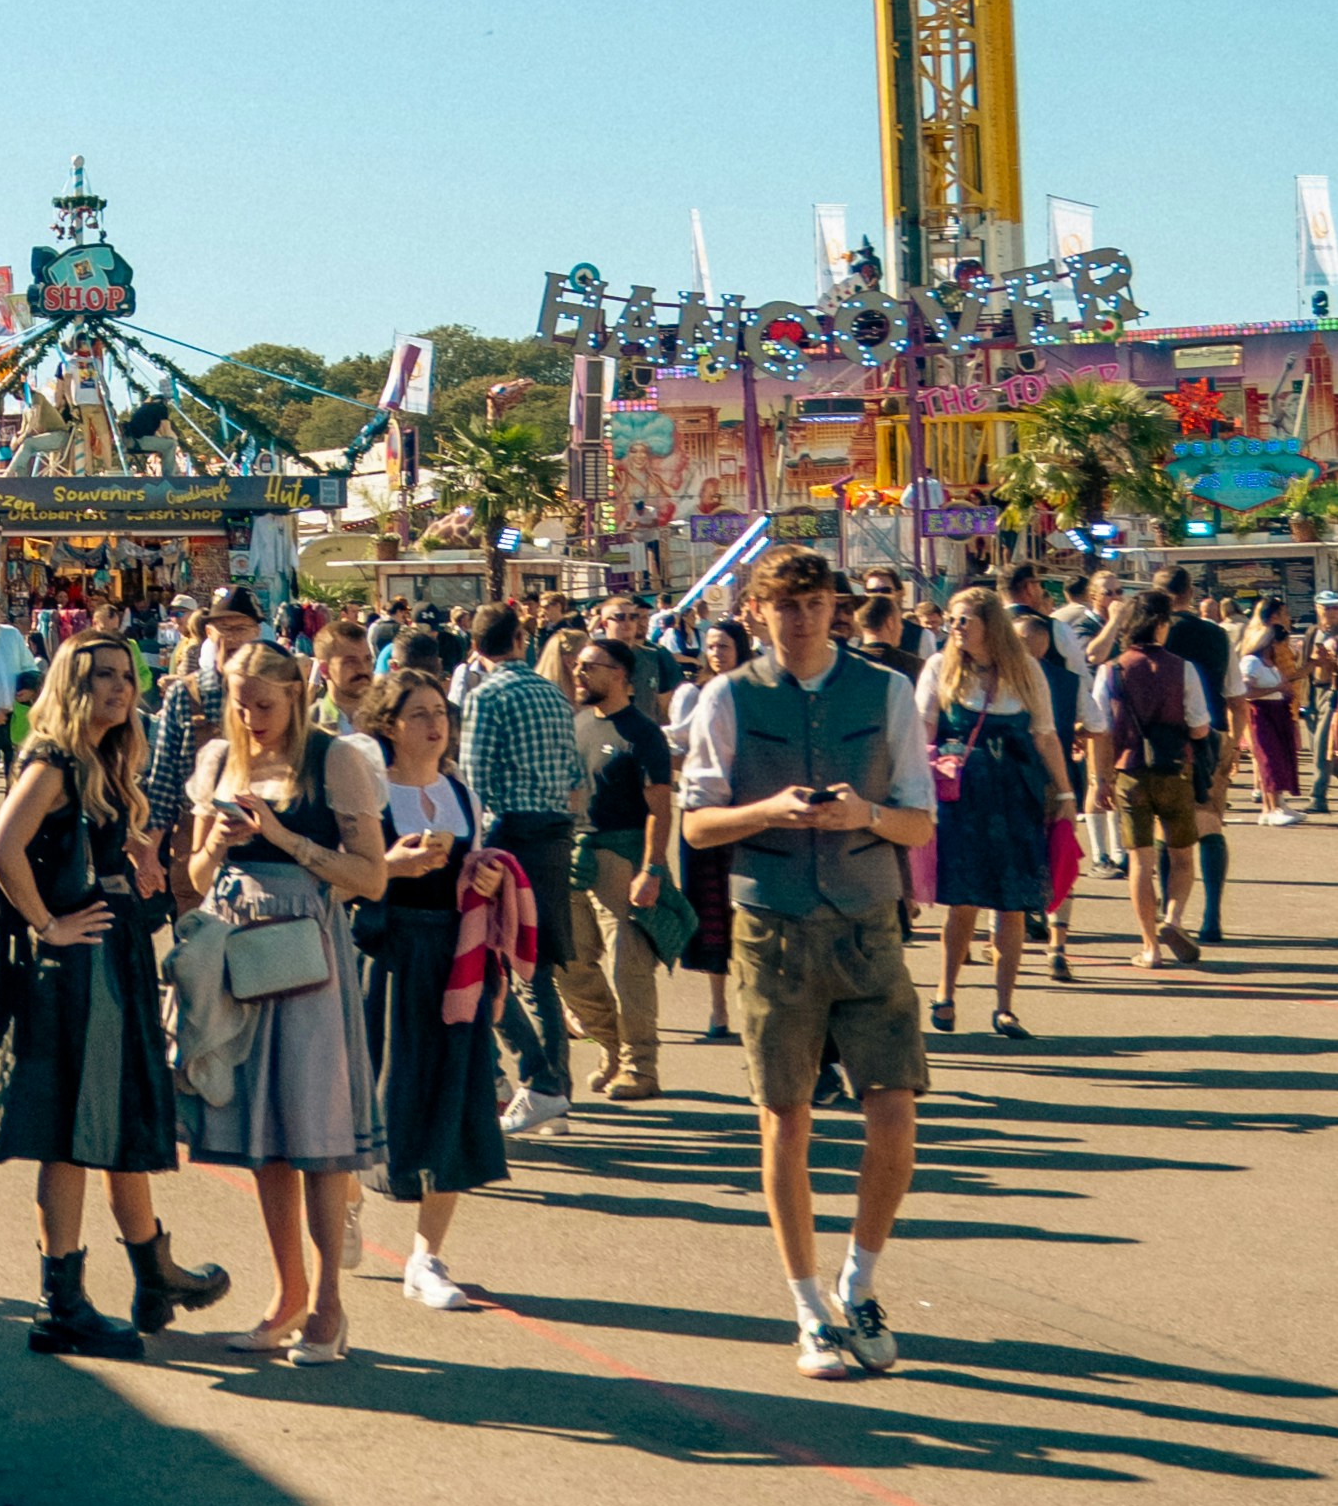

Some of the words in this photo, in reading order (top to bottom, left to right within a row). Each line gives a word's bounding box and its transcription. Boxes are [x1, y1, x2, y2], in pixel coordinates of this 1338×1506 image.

[44, 285, 126, 311] SHOP
[533, 247, 1149, 382] HANGOVER
[916, 383, 988, 419] THE
[53, 486, 145, 502] Souvenirs
[264, 476, 312, 509] Hüte
